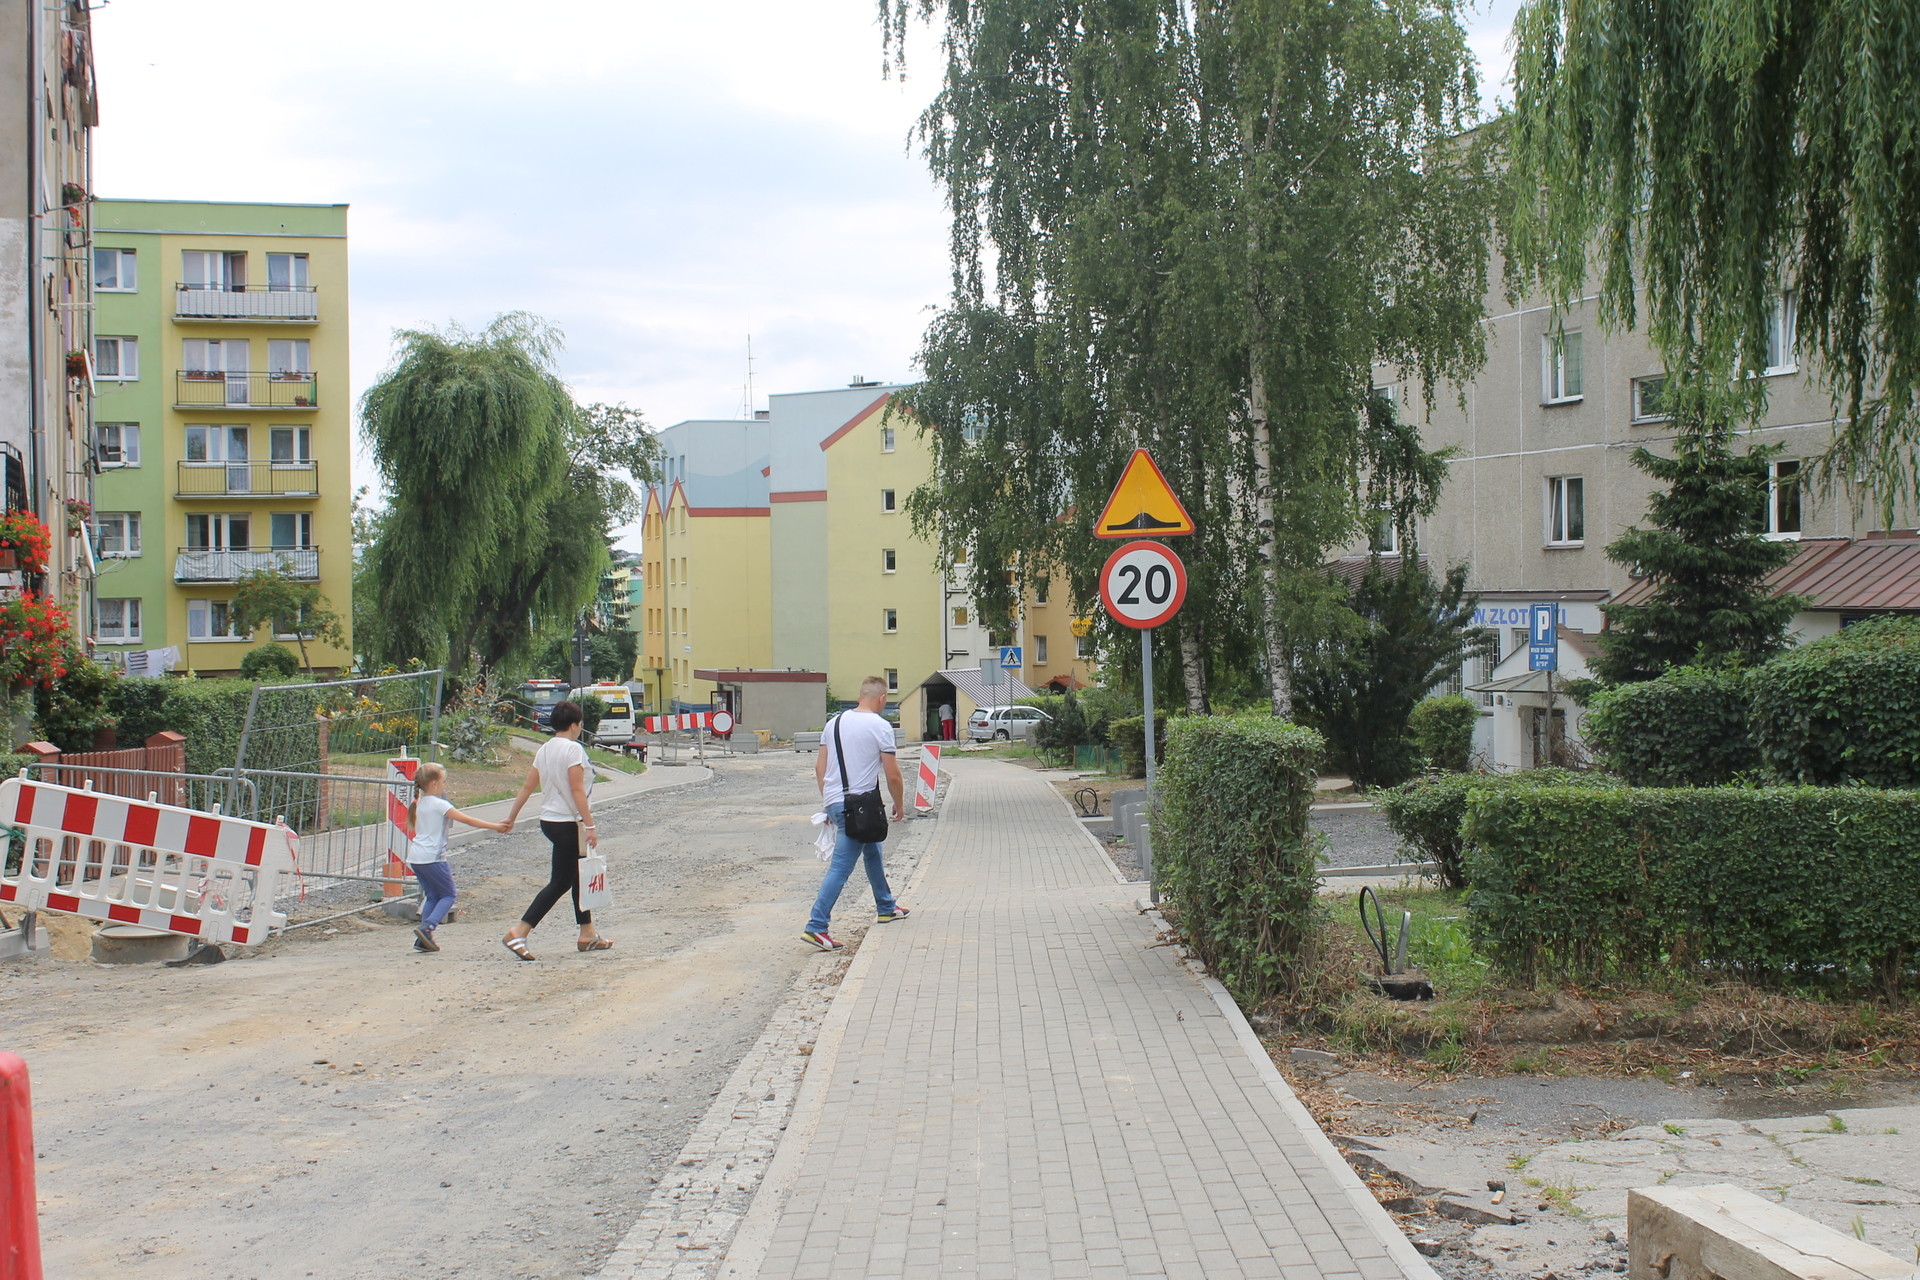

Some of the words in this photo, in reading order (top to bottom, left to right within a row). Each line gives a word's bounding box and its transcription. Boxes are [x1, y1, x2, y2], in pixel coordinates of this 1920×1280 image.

[1117, 564, 1171, 604] 20
[1537, 610, 1550, 641] P
[588, 873, 604, 894] H&M
